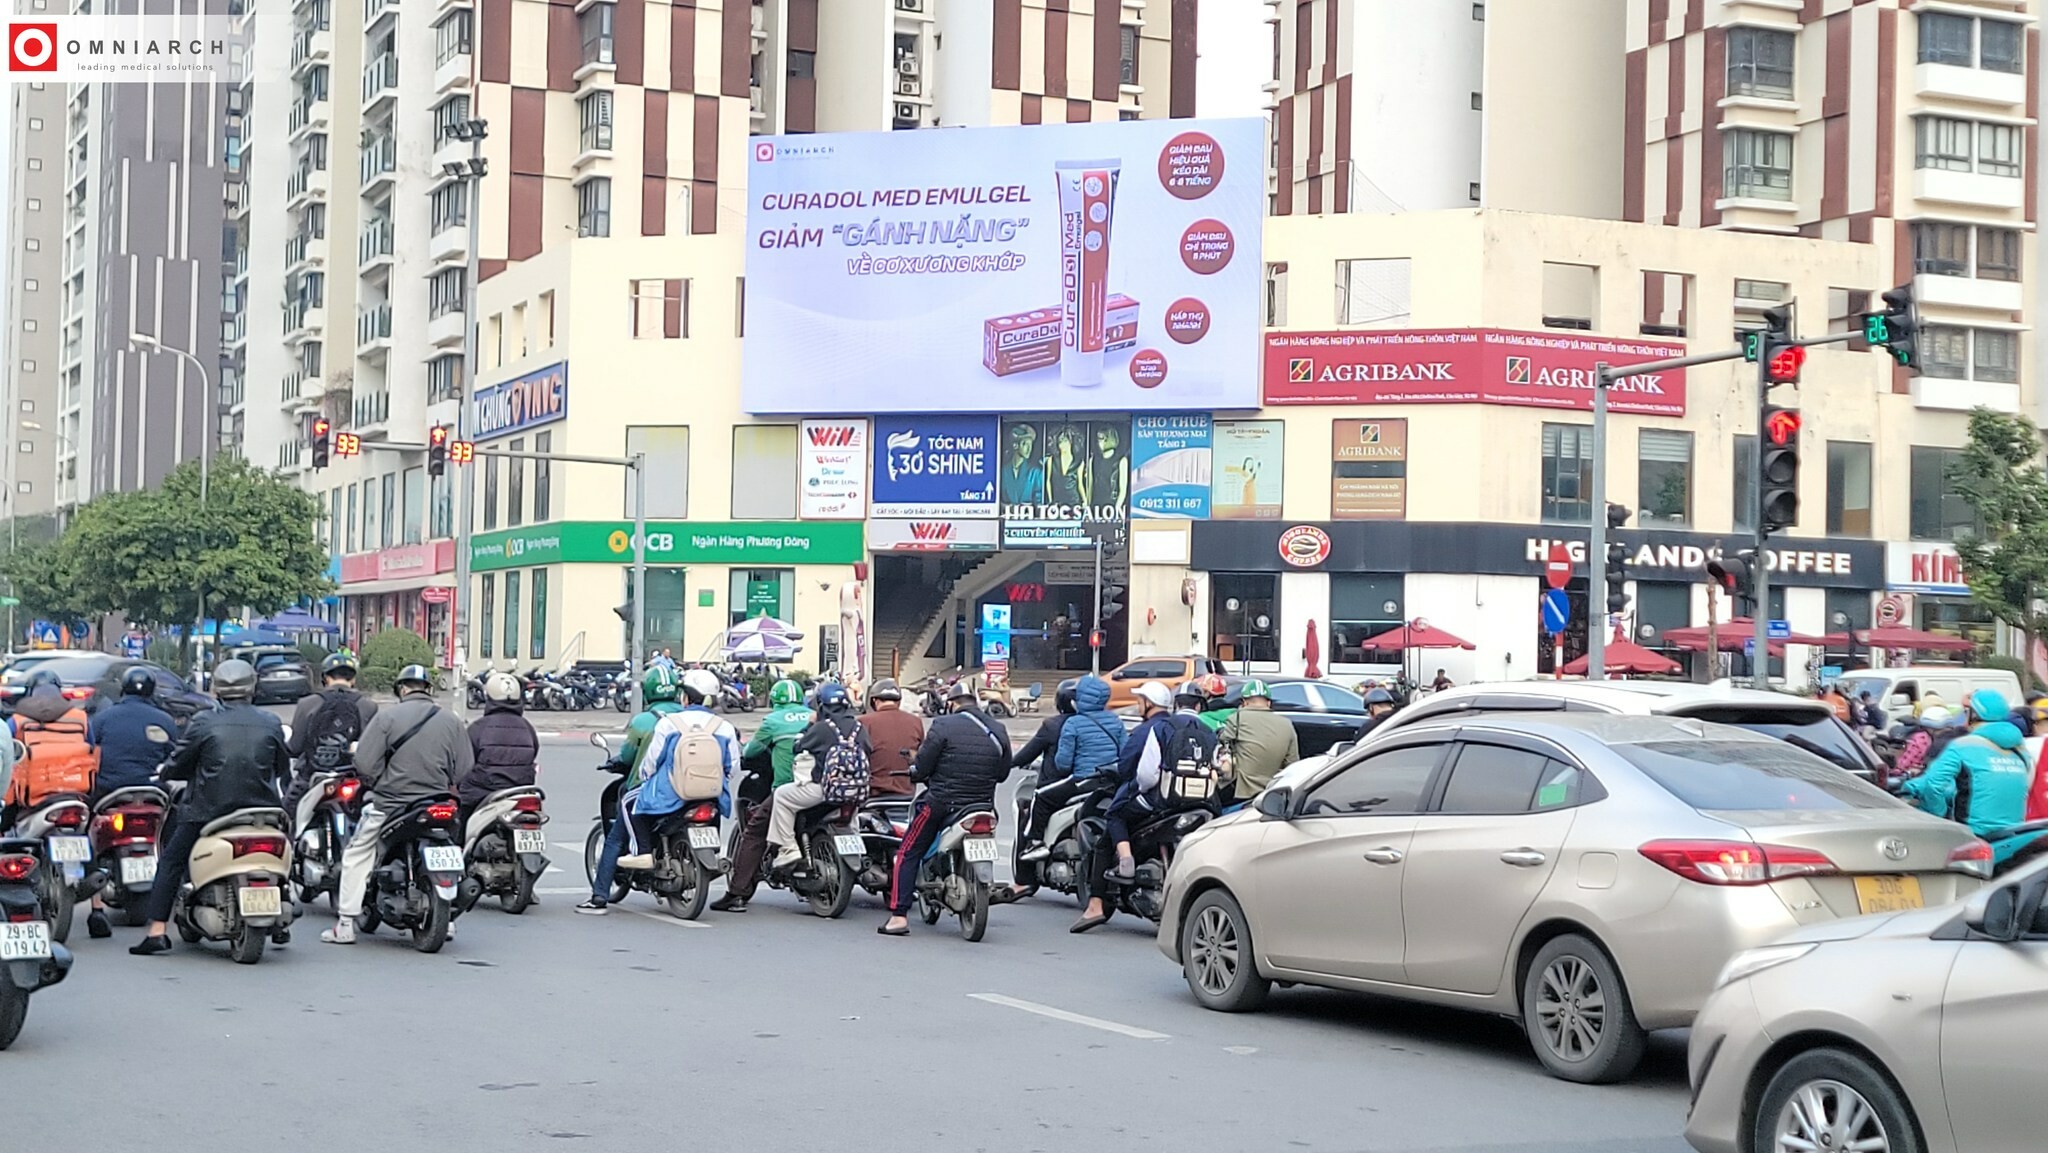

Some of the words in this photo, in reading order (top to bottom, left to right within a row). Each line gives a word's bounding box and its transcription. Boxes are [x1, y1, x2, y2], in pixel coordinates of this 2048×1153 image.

[762, 190, 868, 210] CURADOL
[872, 188, 921, 207] MED
[926, 185, 1032, 205] EMULGEL
[759, 222, 823, 248] GIẢM
[847, 252, 873, 275] VỀ
[899, 254, 970, 274] XƯƠNG
[971, 250, 1026, 272] KHỚP
[1867, 315, 1888, 343] 26
[1317, 363, 1457, 382] AGRIBANK
[1534, 367, 1665, 394] AGRIANK
[1138, 416, 1167, 428] CHO
[928, 434, 954, 450] TÓC
[956, 437, 984, 450] NAM
[1338, 446, 1401, 456] AGRIBANK
[928, 453, 984, 475] SHINE
[1073, 504, 1126, 520] SALON
[1140, 498, 1163, 509] 0912
[1166, 498, 1180, 509] 311
[692, 535, 717, 550] Ngân
[719, 535, 744, 550] Hàng
[747, 535, 783, 549] Phương
[784, 535, 810, 550] Đông
[656, 684, 676, 694] Grab
